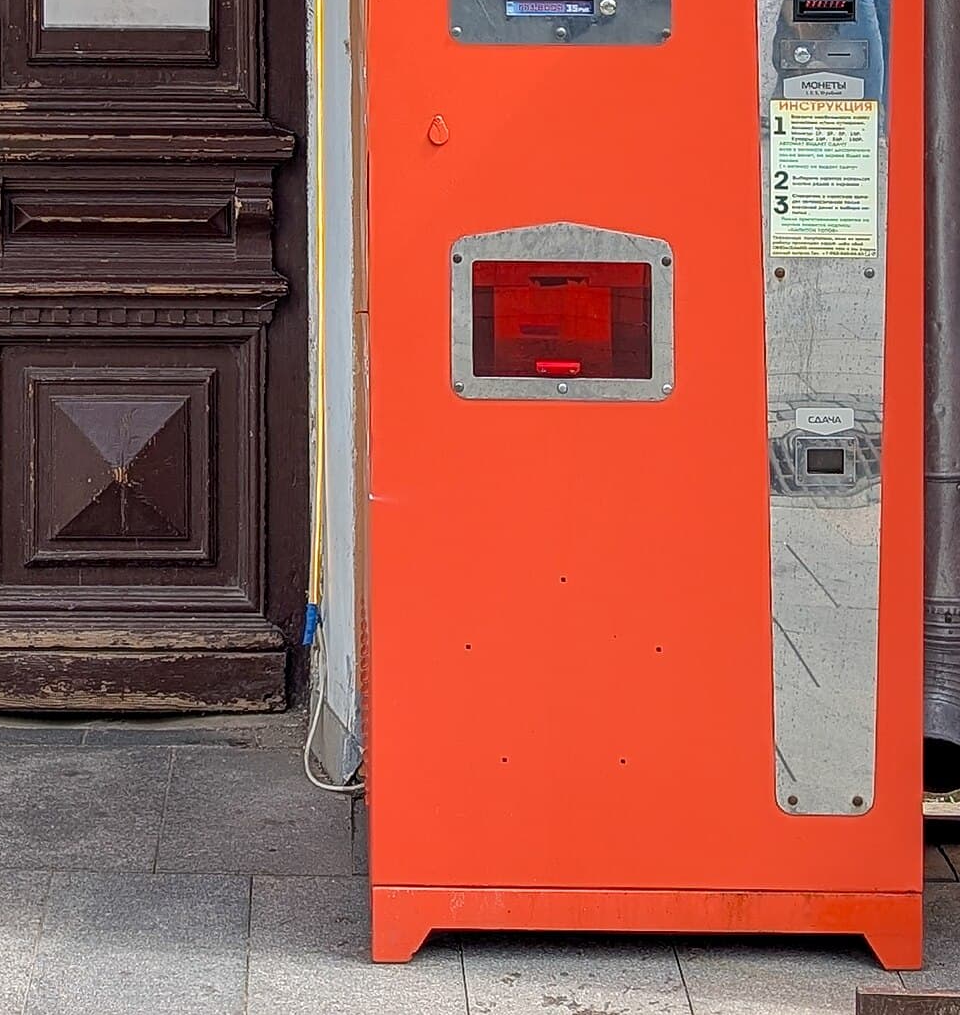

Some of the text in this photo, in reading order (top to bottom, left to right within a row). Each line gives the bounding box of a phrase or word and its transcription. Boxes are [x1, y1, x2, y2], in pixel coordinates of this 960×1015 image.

[801, 81, 847, 90] МОНЕТЫ
[778, 100, 873, 113] ИНСТРУКЦИЯ
[773, 116, 787, 135] 1
[773, 170, 789, 190] 2
[773, 195, 789, 215] 3
[808, 415, 842, 424] СДАЧА
